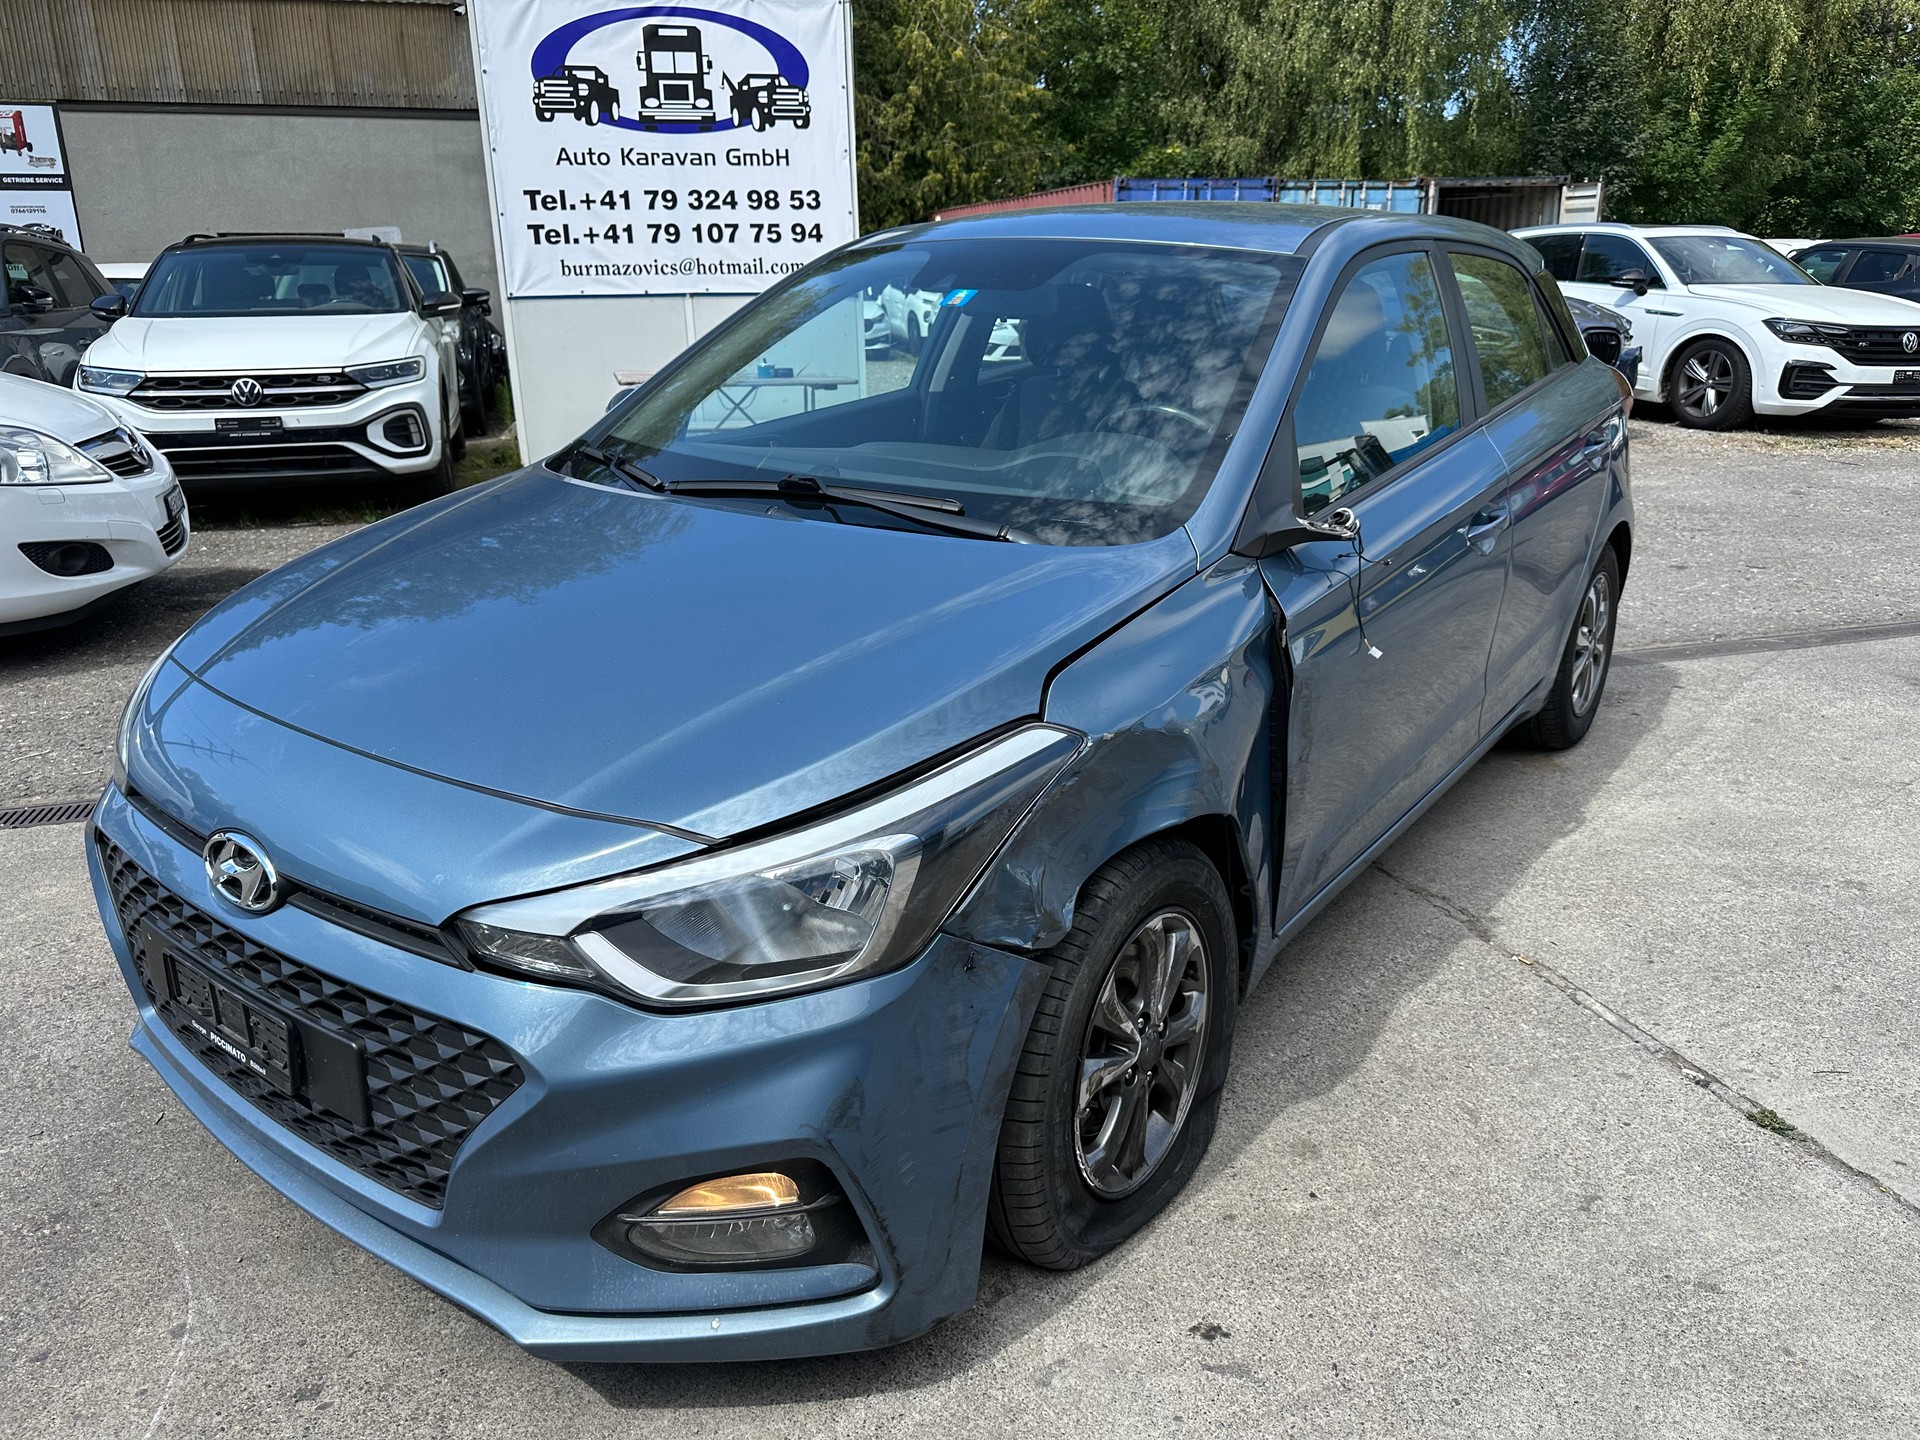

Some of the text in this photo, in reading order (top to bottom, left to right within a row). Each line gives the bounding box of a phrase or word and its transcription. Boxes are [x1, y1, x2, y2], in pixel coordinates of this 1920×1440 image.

[556, 147, 790, 167] Auto Karavan GmbH
[2, 176, 35, 184] GETRIEBE
[523, 189, 821, 211] Tel.+41 79 324 98 53
[526, 223, 823, 245] Tel.+41 79 107 75 94
[209, 1031, 247, 1063] PICCINATO
